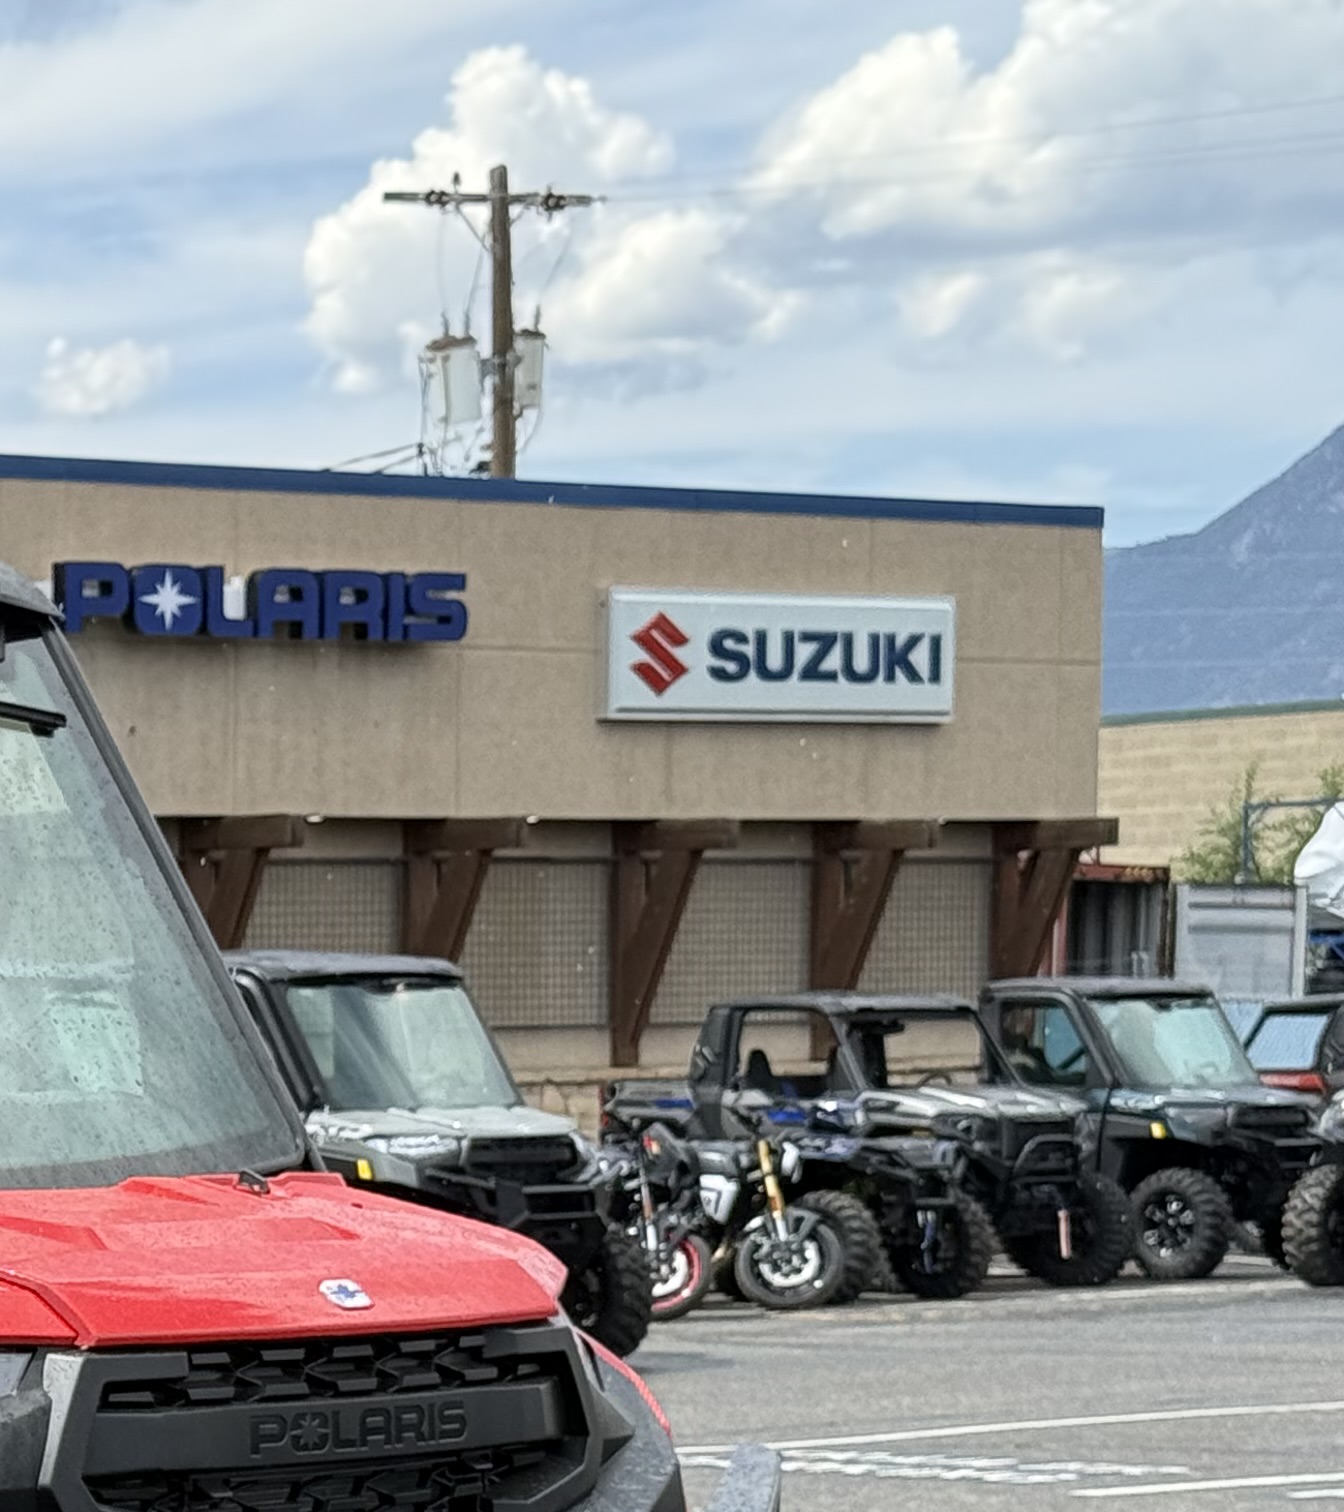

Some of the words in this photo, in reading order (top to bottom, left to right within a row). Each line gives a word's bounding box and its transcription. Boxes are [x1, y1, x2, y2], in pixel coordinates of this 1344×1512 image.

[54, 561, 468, 641] POLARIS
[706, 629, 943, 684] SUZUKI
[249, 1401, 468, 1459] POLARIS
